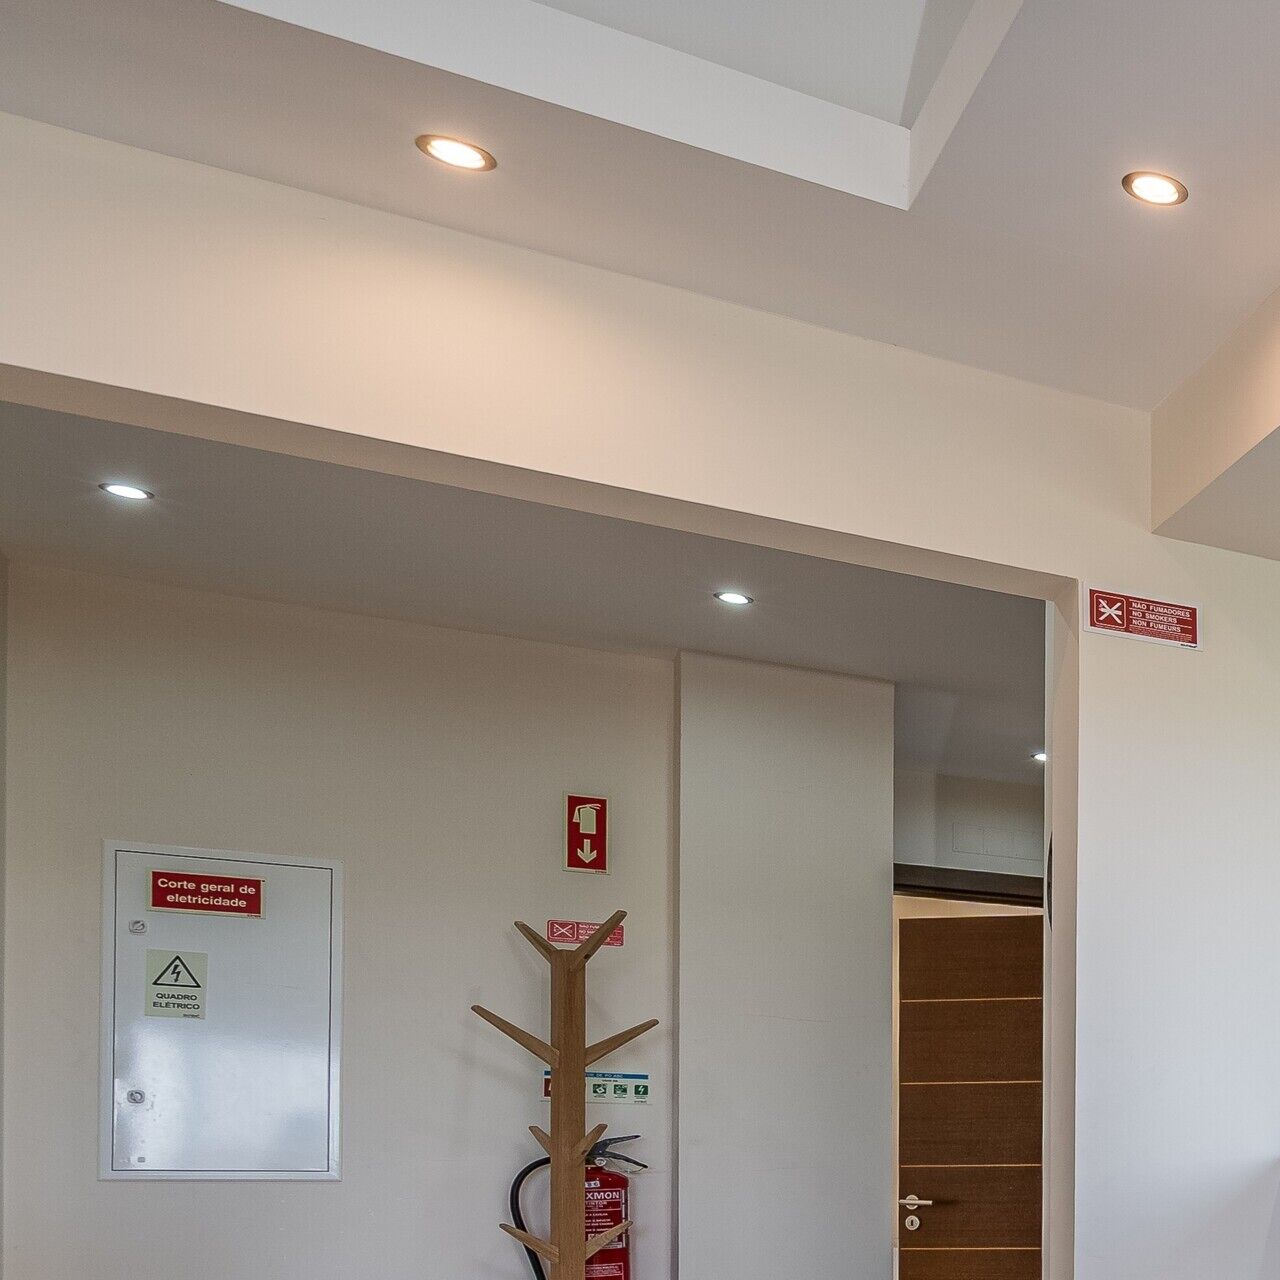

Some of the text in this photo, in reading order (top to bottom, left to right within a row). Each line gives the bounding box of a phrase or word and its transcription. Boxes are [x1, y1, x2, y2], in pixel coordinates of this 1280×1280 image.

[1132, 601, 1190, 618] NÃO FUMADORES
[1145, 612, 1177, 624] SMOKERS
[1132, 619, 1181, 632] NON FUMEURS
[157, 878, 256, 894] Corte geral de
[166, 893, 247, 908] eletricidade
[156, 992, 198, 1001] QUADRO
[152, 1001, 200, 1010] ELÉTRICO
[586, 1191, 620, 1200] XMON
